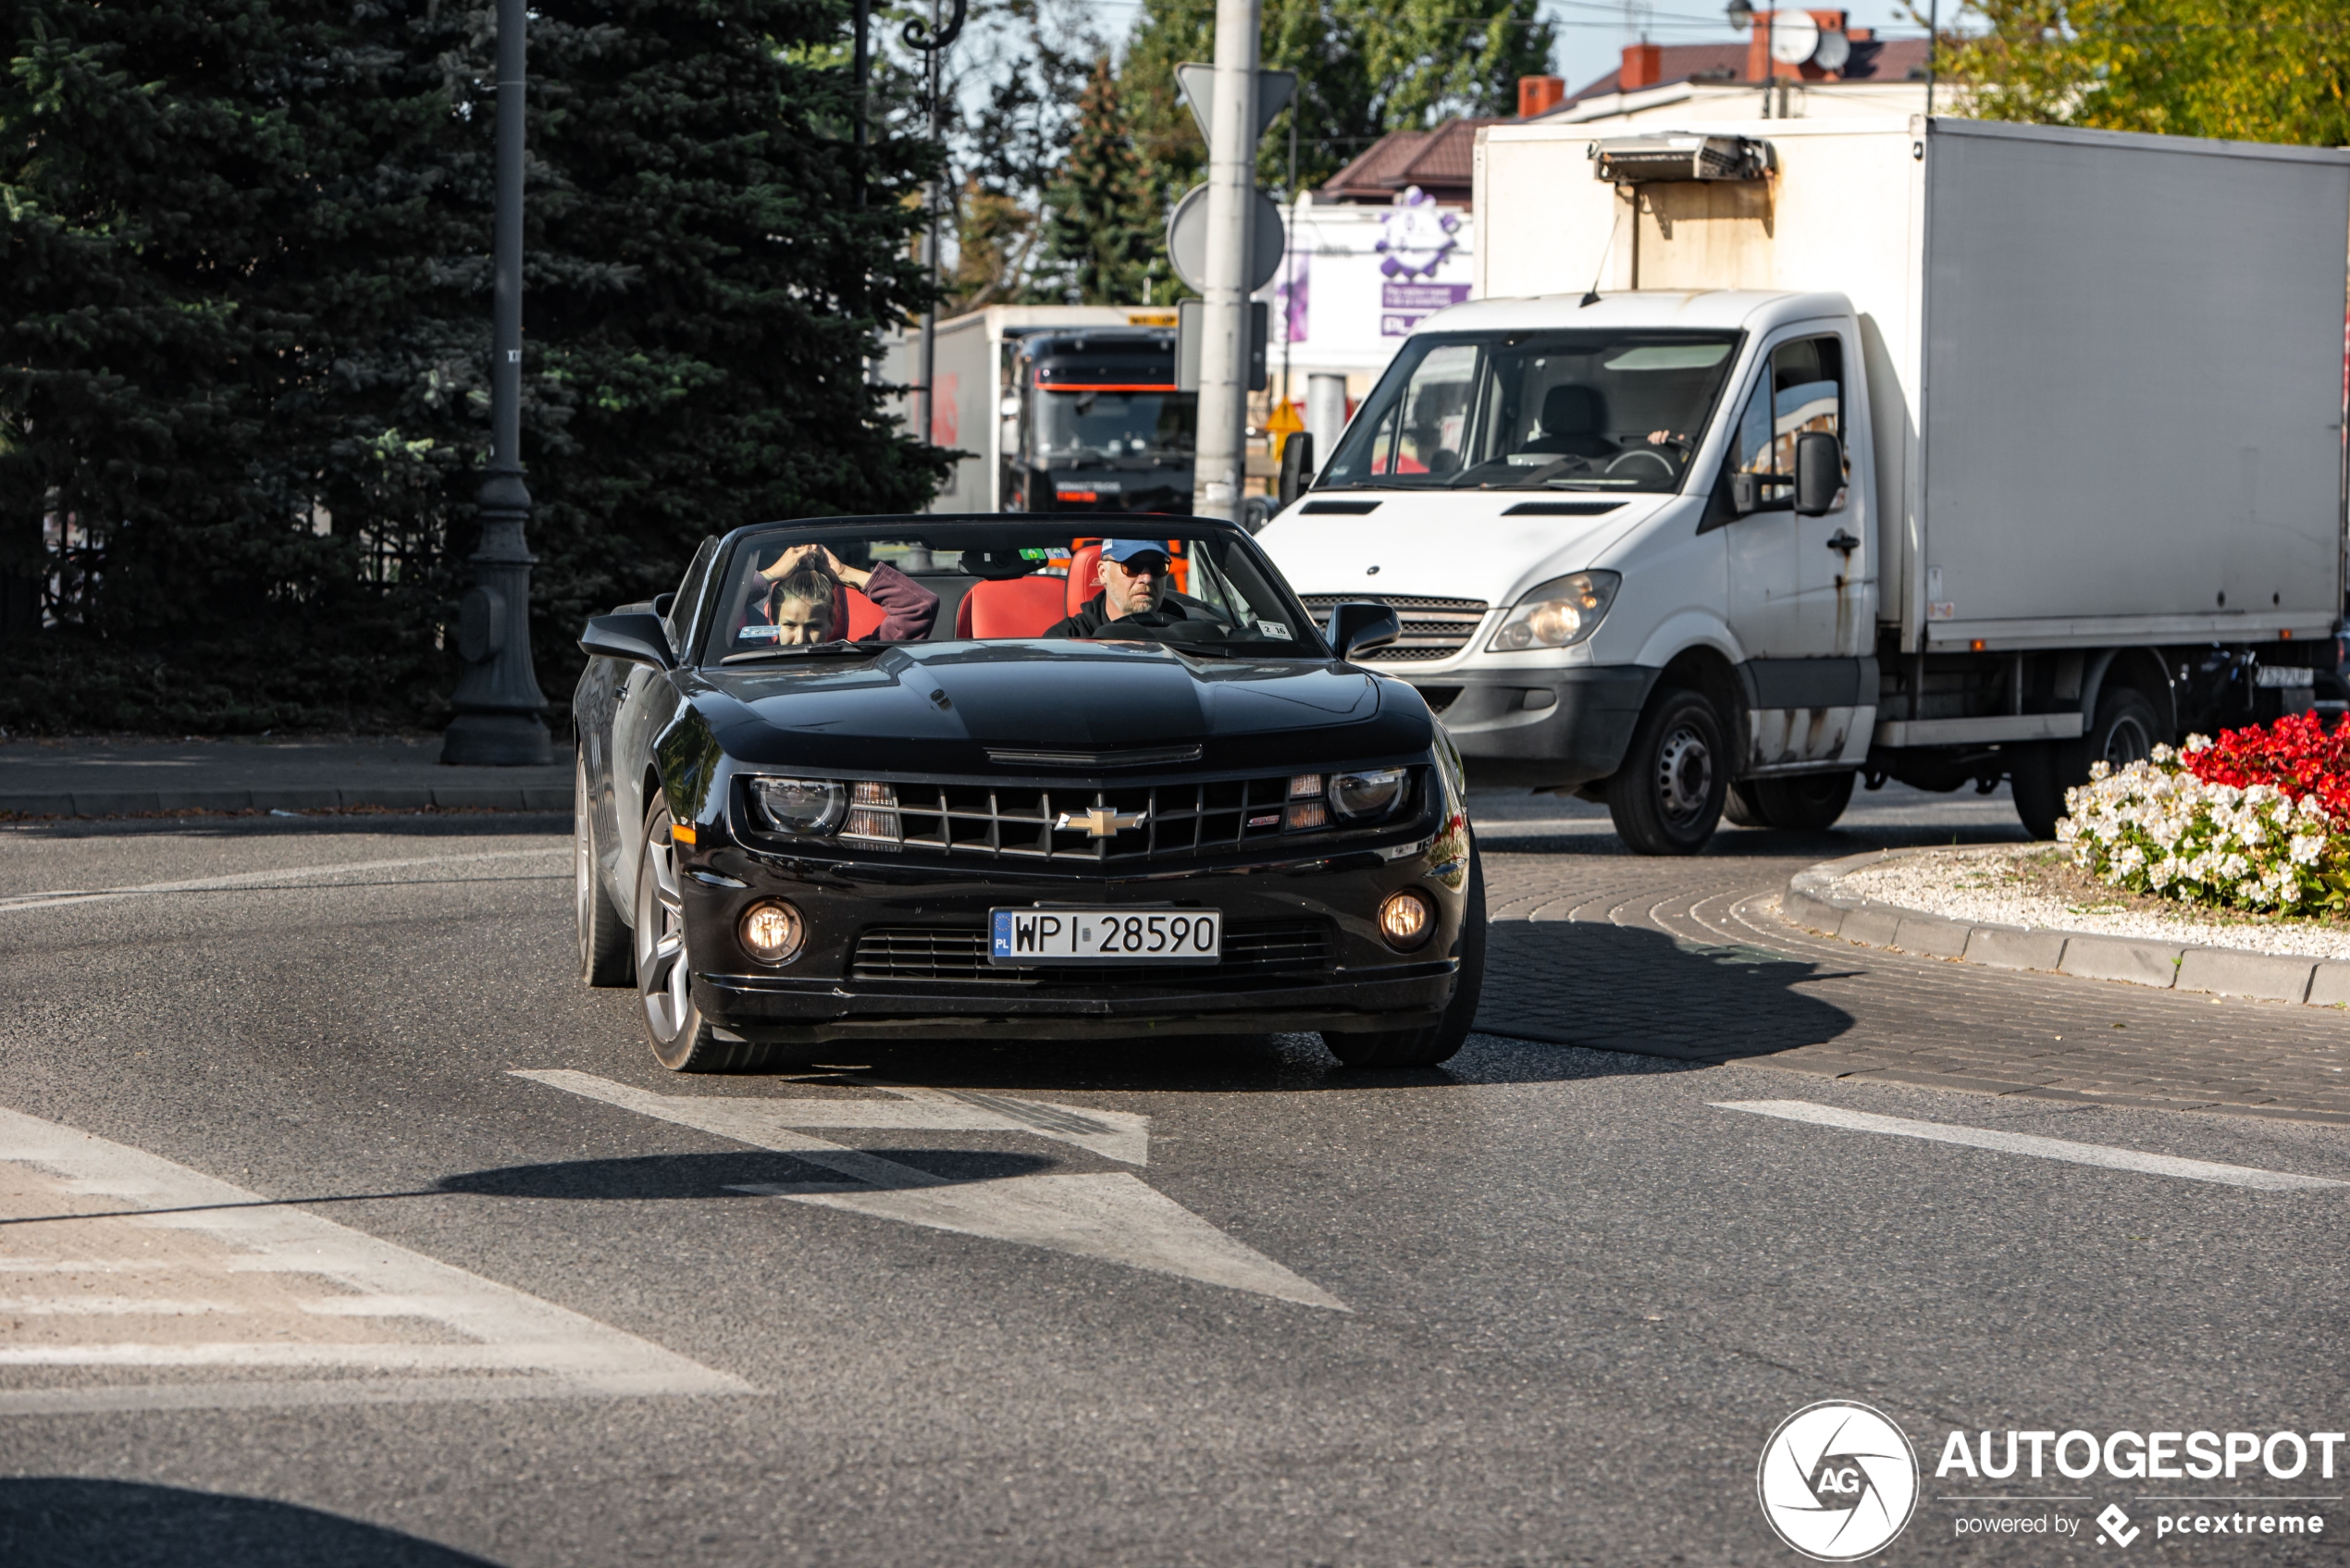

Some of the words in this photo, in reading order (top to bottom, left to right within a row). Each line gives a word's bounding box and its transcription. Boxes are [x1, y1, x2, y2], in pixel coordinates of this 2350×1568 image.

[996, 938, 1009, 949] PL
[1015, 916, 1078, 953] WPI
[1099, 916, 1214, 953] 28590
